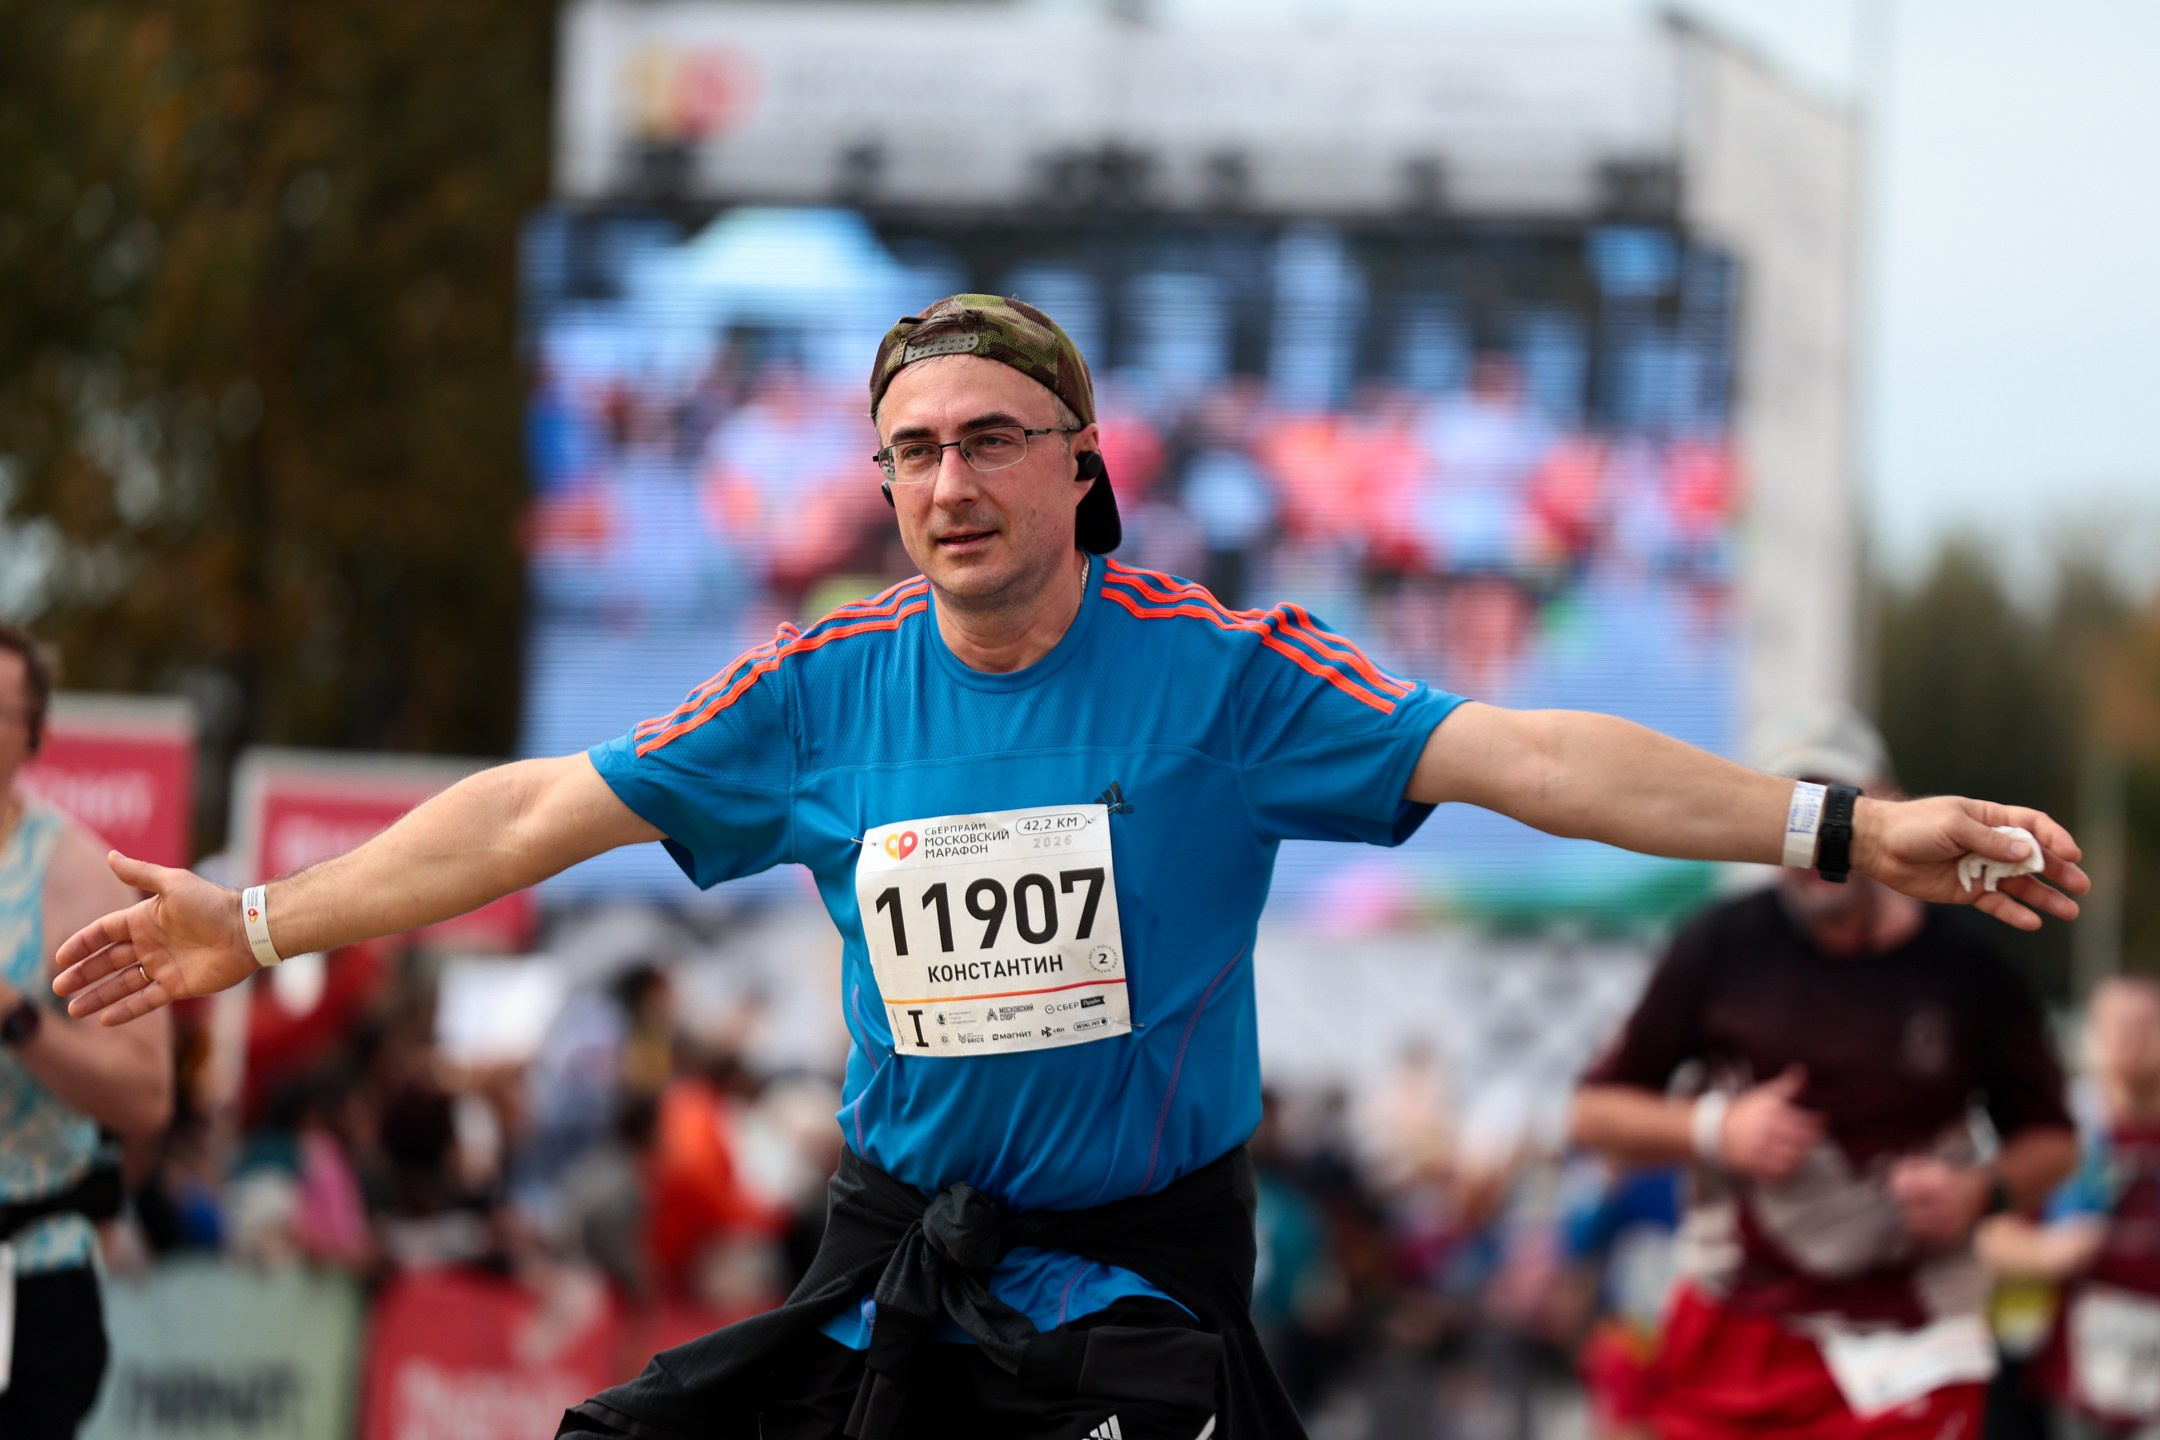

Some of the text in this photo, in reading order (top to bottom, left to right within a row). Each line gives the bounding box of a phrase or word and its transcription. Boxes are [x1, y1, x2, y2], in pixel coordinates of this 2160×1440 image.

[925, 822, 987, 836] СБЕРПРАЙМ
[1024, 817, 1078, 831] 42,2 КМ
[925, 829, 1010, 847] МОСКОВСКИЙ
[925, 846, 989, 858] МАРАФОН
[875, 867, 1106, 956] 11907
[1098, 953, 1108, 964] 2
[927, 954, 1063, 983] КОНСТАНТИН
[999, 1003, 1034, 1014] МОСКОВСКИЙ
[1056, 1002, 1079, 1012] СБЕР
[1000, 1013, 1016, 1021] СПОРТ
